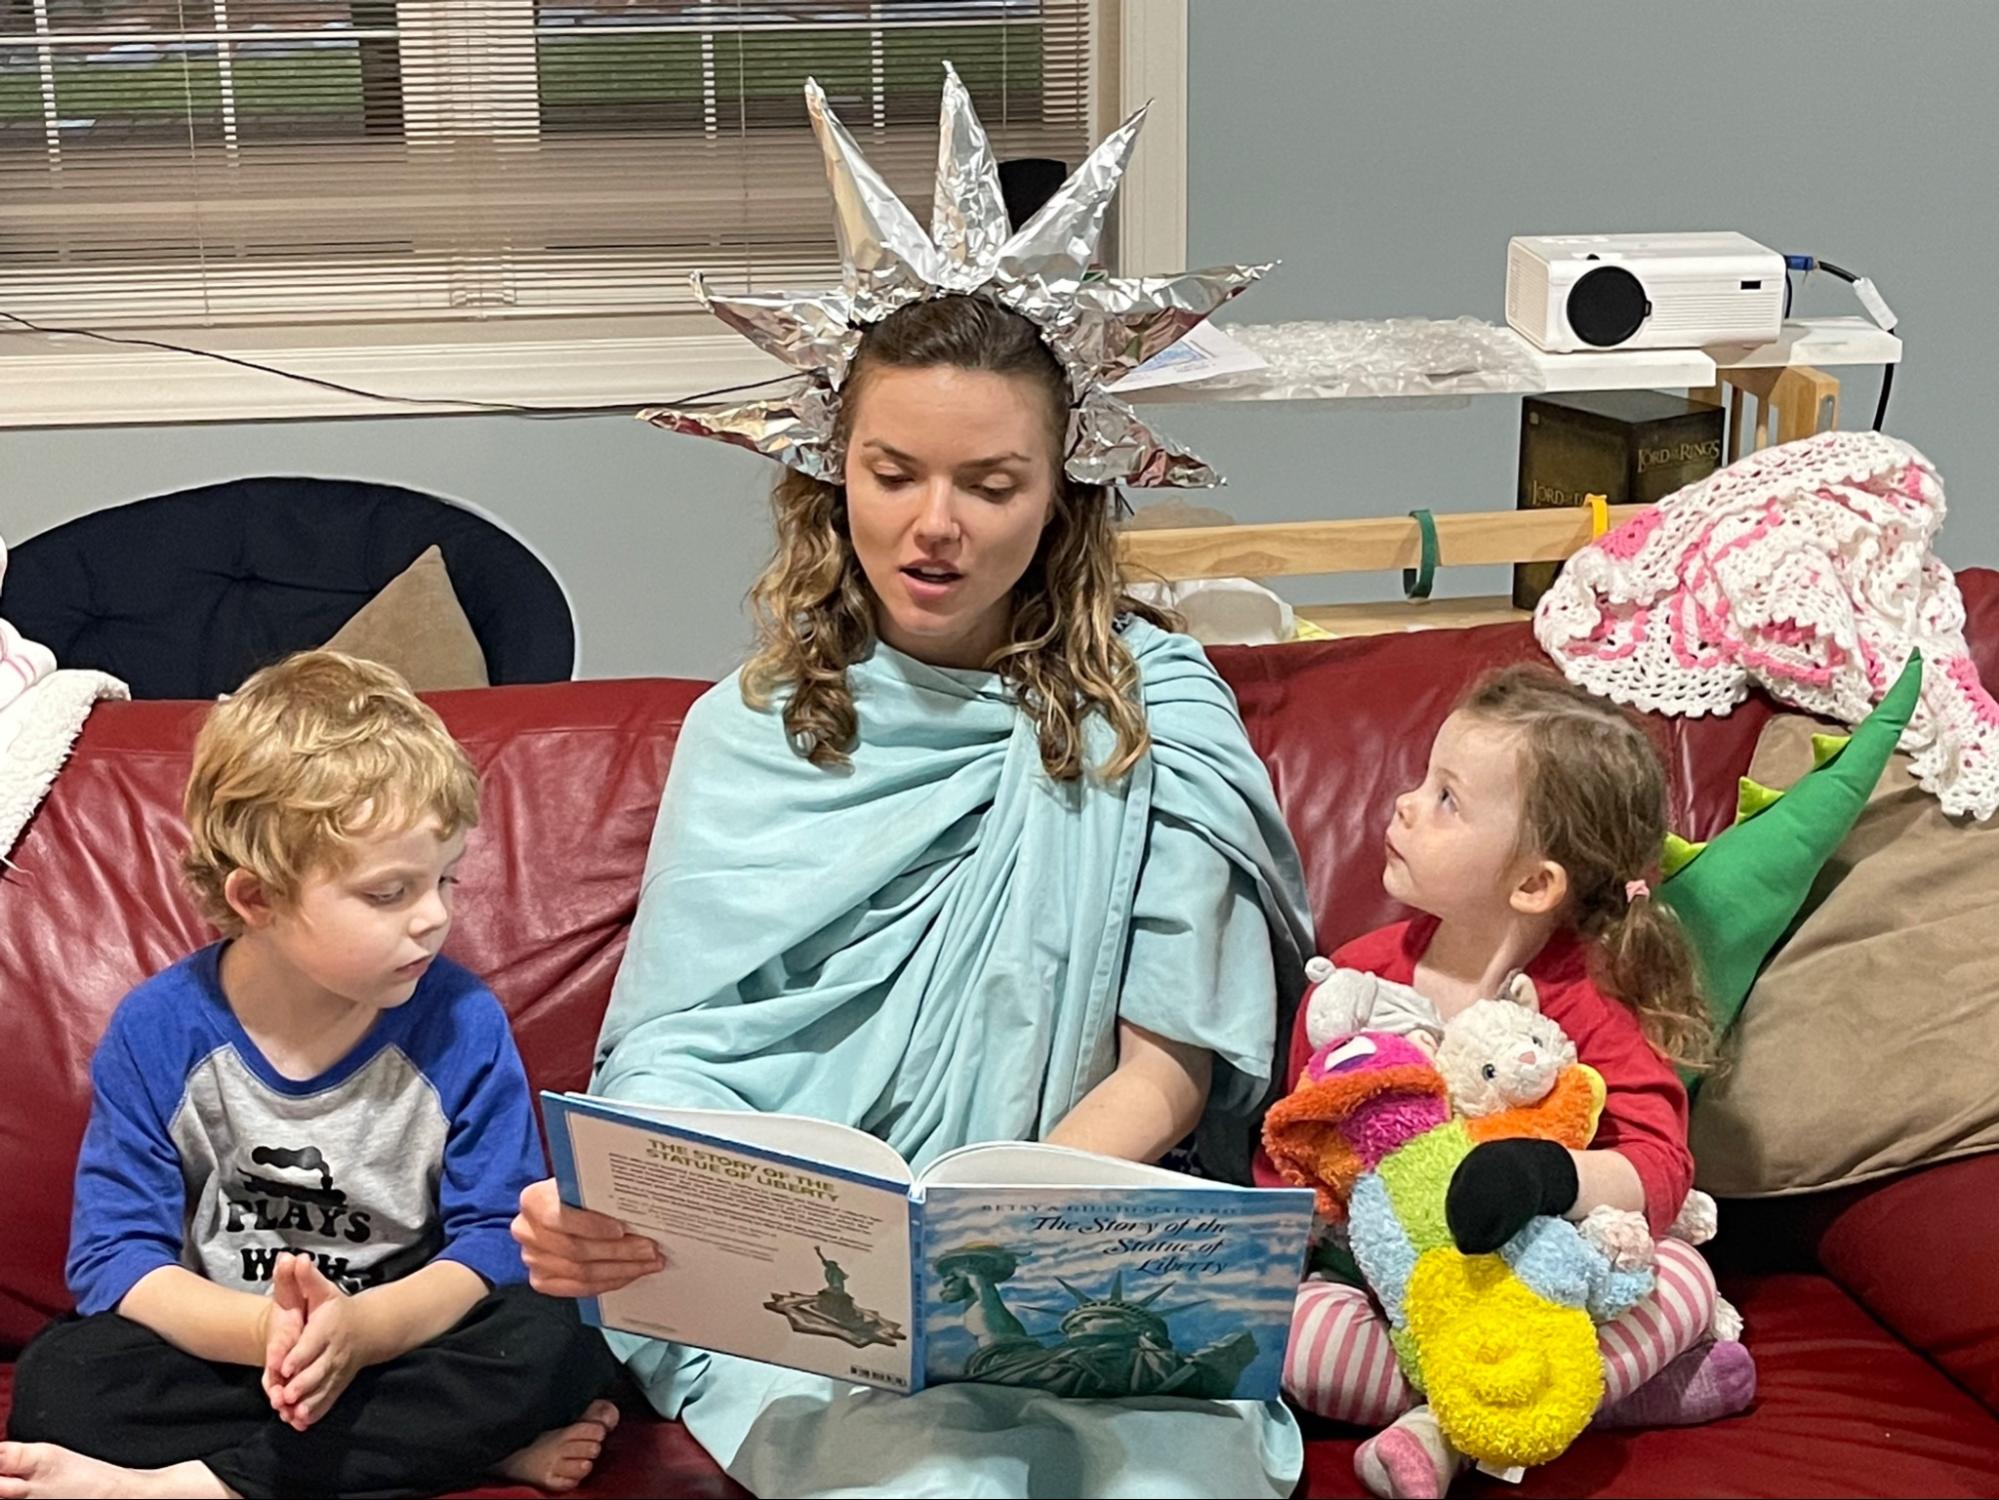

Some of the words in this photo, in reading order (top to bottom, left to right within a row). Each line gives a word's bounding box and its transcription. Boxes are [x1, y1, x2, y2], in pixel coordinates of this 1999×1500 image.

[1637, 448, 1671, 473] LORD
[1680, 440, 1720, 461] RINGS
[646, 1147, 721, 1177] STATUE
[725, 1168, 750, 1180] OF
[757, 1175, 839, 1202] LIBERTY
[648, 1139, 687, 1156] THE
[692, 1149, 758, 1173] STORY
[763, 1167, 790, 1179] OF
[795, 1174, 835, 1191] THE
[226, 1199, 371, 1243] PLAYS
[1031, 1216, 1077, 1231] The
[1078, 1218, 1159, 1235] Story
[1165, 1218, 1191, 1236] of
[1195, 1218, 1226, 1233] the
[1103, 1238, 1193, 1255] Statue
[1198, 1239, 1225, 1256] of
[240, 1247, 350, 1282] WH
[1136, 1257, 1227, 1275] Liberty
